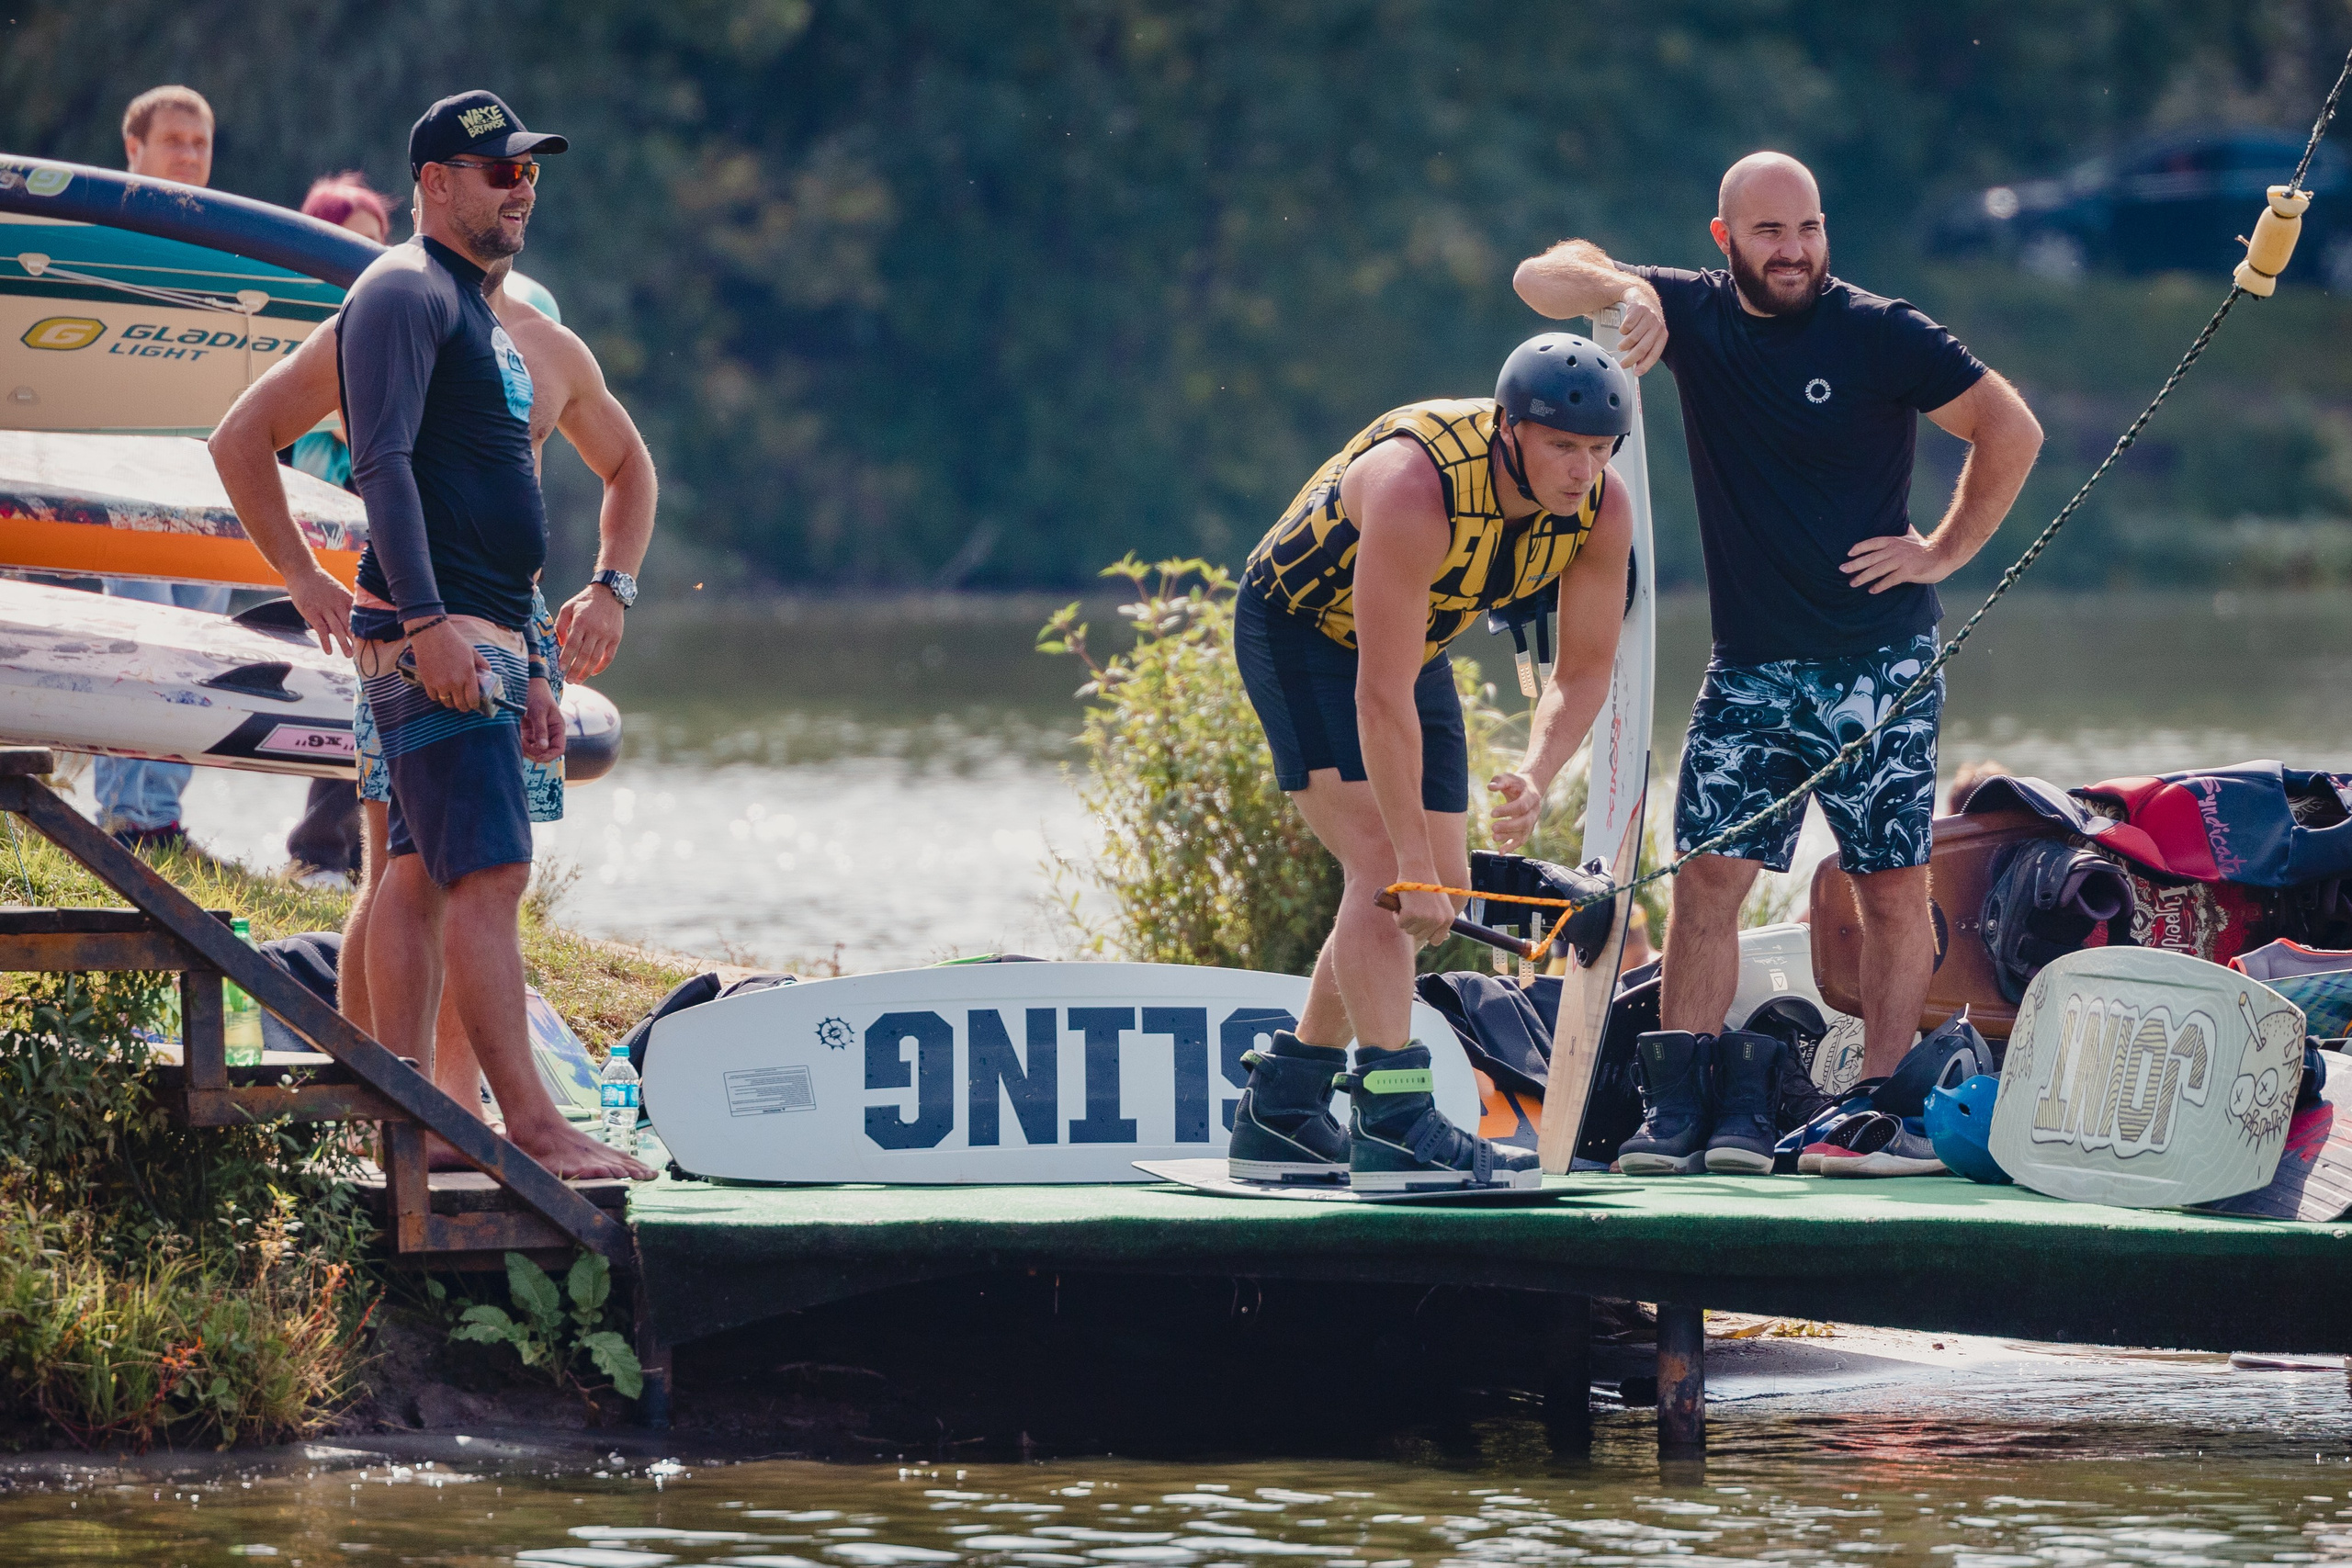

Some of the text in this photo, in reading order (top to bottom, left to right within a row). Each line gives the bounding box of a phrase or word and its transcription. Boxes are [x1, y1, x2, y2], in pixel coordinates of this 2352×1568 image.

[108, 342, 209, 362] LIGHT
[2197, 778, 2248, 880] Syndicate
[2032, 1001, 2211, 1151] JOINT
